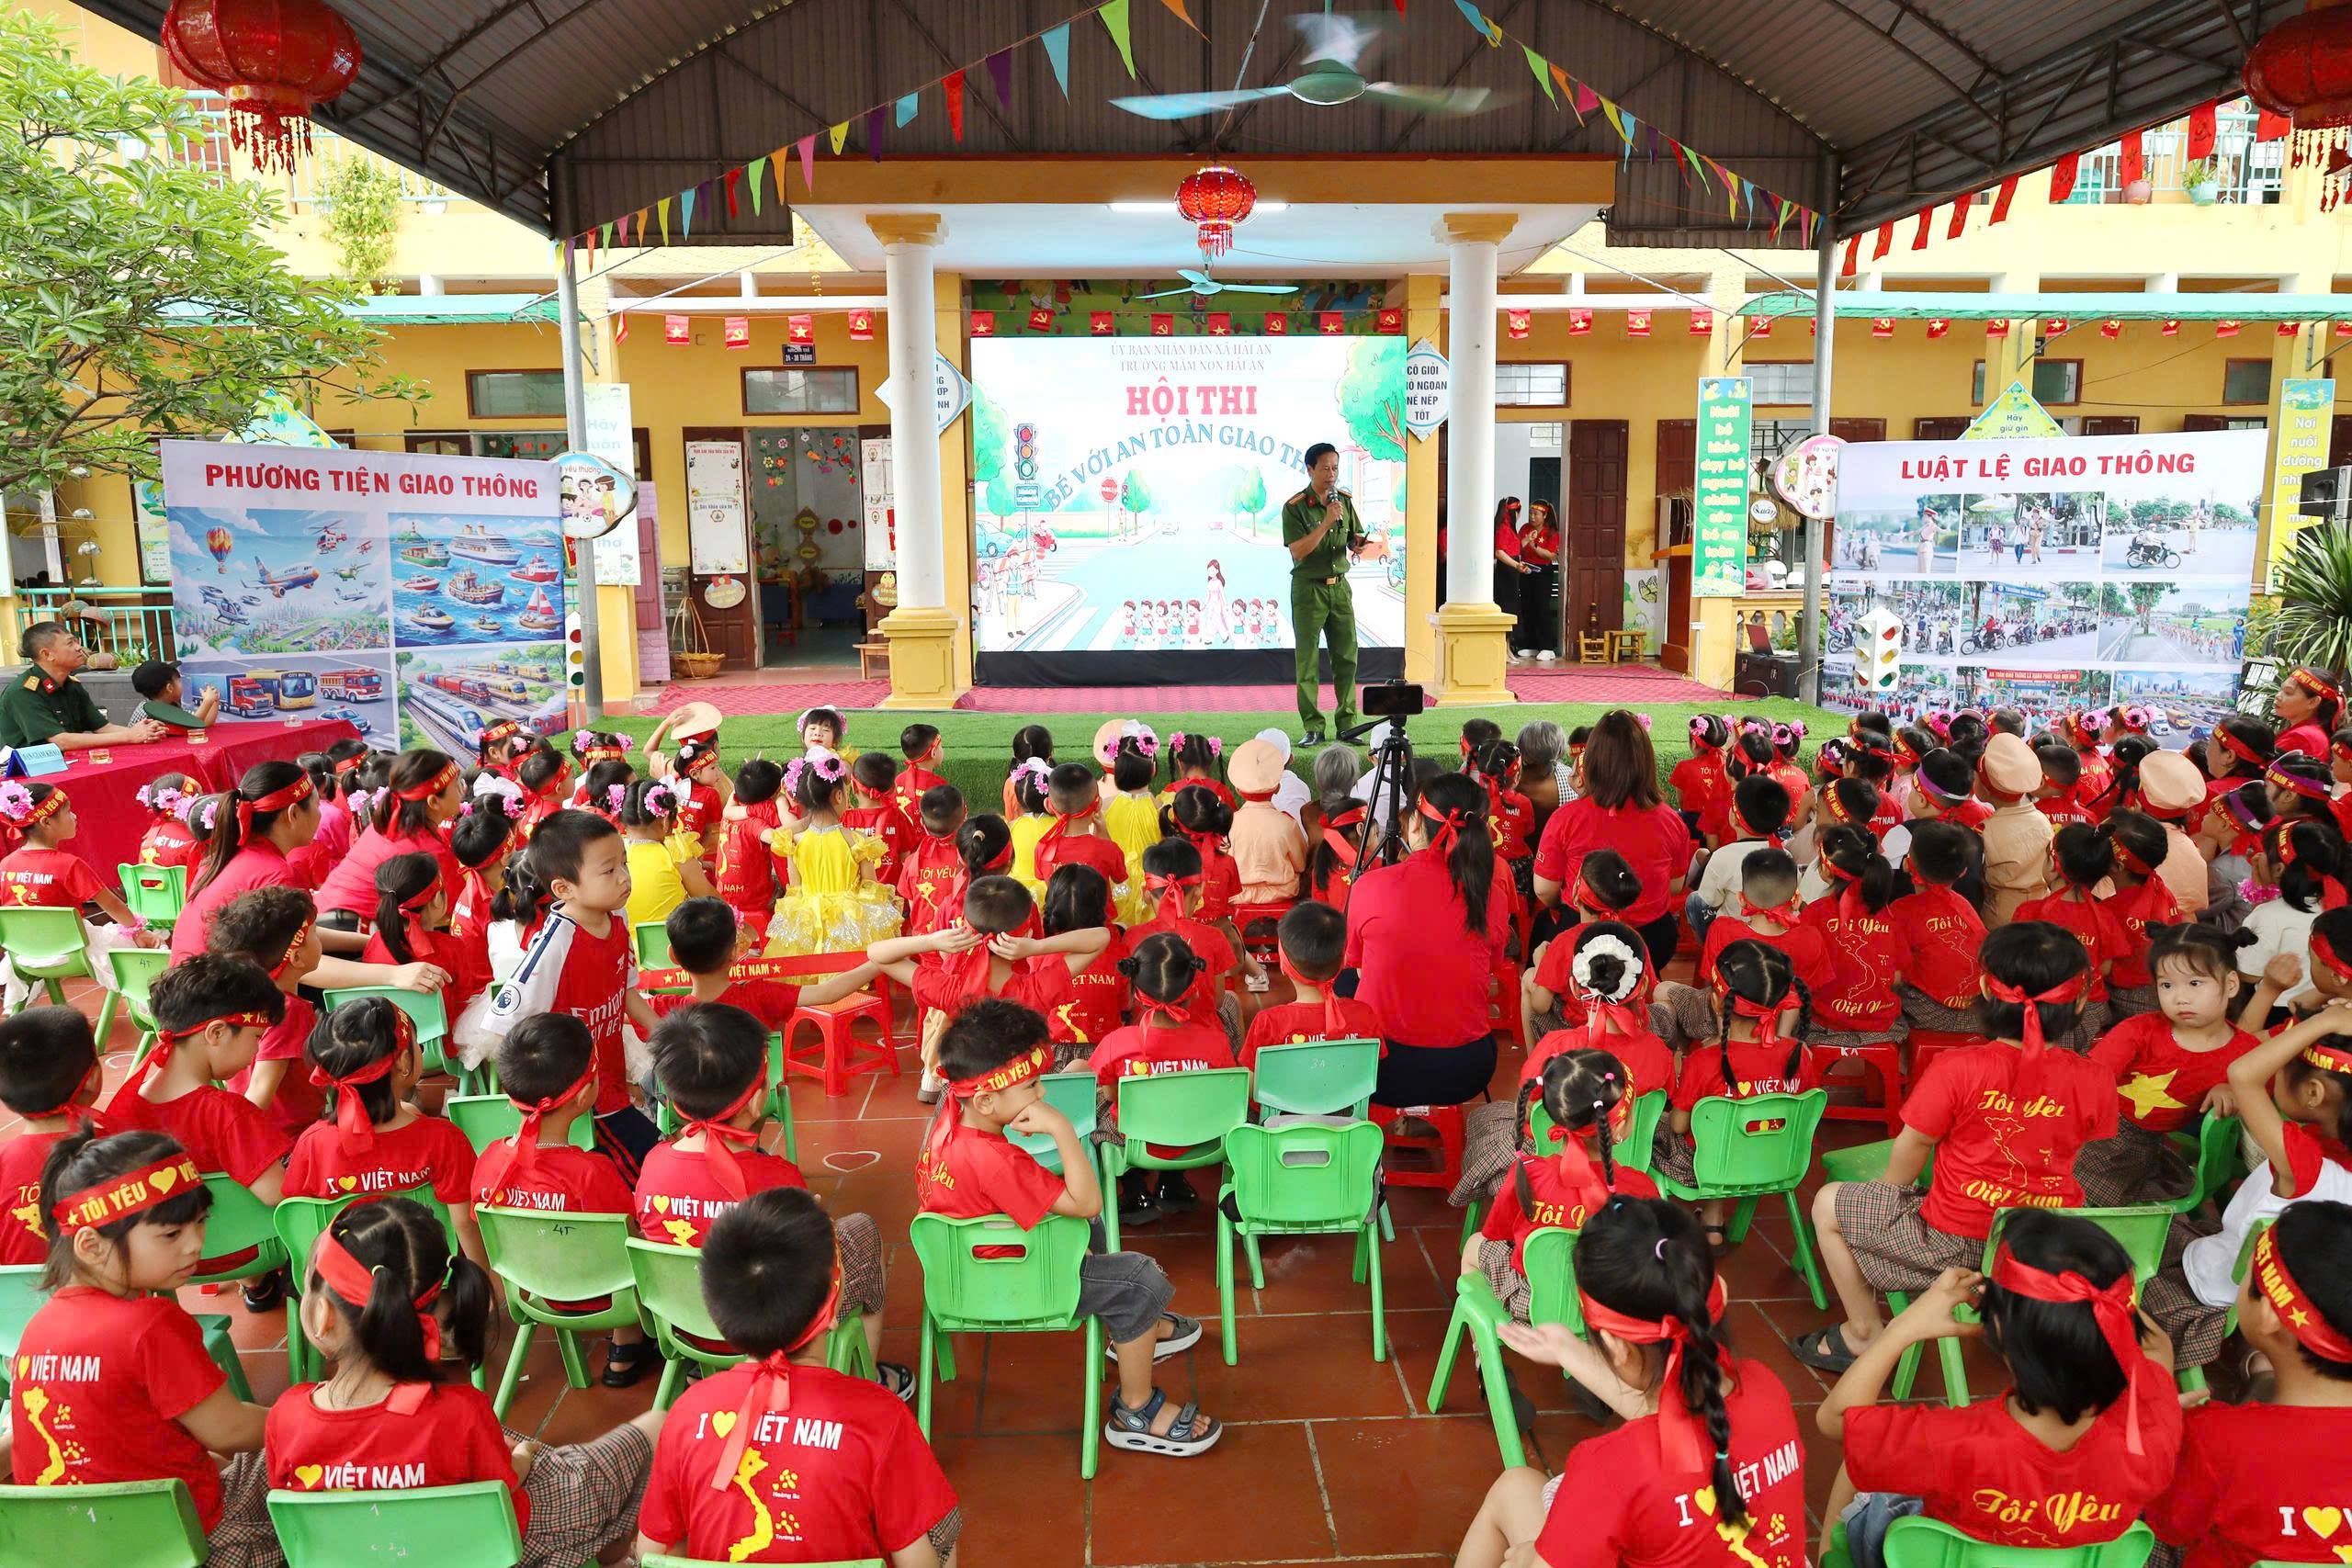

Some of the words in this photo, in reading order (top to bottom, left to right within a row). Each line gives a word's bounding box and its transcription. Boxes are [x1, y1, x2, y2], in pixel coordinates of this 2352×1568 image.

[1129, 344, 1149, 355] BAN
[1154, 342, 1185, 355] NHÂN
[1190, 342, 1212, 355] DÂN
[1256, 344, 1272, 355] AN
[1200, 360, 1222, 371] NON
[1408, 364, 1419, 375] CÔ
[1421, 361, 1439, 375] GIỎI
[1417, 381, 1447, 390] NGOAN
[1126, 376, 1189, 423] HỘI
[1196, 386, 1257, 414] THI
[1415, 408, 1430, 420] TỐT
[2295, 417, 2316, 429] Nơi
[2290, 436, 2318, 447] nuôi
[1044, 473, 1073, 512] BÉ
[1071, 448, 1113, 483] VỚI
[1117, 433, 1147, 462] AN
[1149, 419, 1213, 448] TOÀN
[1219, 425, 1274, 456] GIAO
[1902, 455, 1968, 482] LUẬT
[1979, 453, 2010, 480] LỆ
[2024, 457, 2086, 476] GIAO
[2098, 449, 2194, 475] THÔNG
[2281, 454, 2323, 469] dưỡng
[205, 462, 320, 491] PHƯƠNG
[329, 467, 390, 496] TIỆN
[399, 474, 454, 495] GIAO
[462, 472, 537, 499] THÔNG
[35, 808, 46, 818] TÔI
[44, 799, 58, 814] YÊU
[1831, 801, 1844, 818] NAM
[17, 871, 32, 884] VIỆT
[33, 874, 53, 885] NAM
[920, 866, 933, 880] TÔI
[936, 866, 957, 879] YÊU
[1859, 919, 1889, 934] Yêu
[1927, 917, 1951, 933] Tôi
[291, 929, 305, 948] YÊU
[749, 963, 770, 976] NAM
[1089, 974, 1115, 987] NAM
[1831, 998, 1864, 1014] Việt
[1125, 1059, 1131, 1075] I
[2304, 1046, 2335, 1070] NAM
[987, 1070, 1009, 1091] TÔI
[1008, 1058, 1031, 1086] YÊU
[1977, 1090, 2015, 1114] Tôi
[326, 1178, 339, 1195] I
[362, 1168, 394, 1192] VIỆT
[398, 1166, 432, 1185] NAM
[17, 1181, 41, 1205] TÔ
[80, 1200, 108, 1224] TÔI
[108, 1179, 148, 1213] YÊU
[532, 1191, 565, 1212] NAM
[1961, 1179, 2011, 1207] Việt
[644, 1196, 650, 1213] I
[671, 1195, 700, 1219] VIỆT
[1531, 1200, 1563, 1224] Tôi
[2263, 1260, 2294, 1308] NAM
[30, 1348, 58, 1385] VIỆT
[60, 1355, 101, 1382] NAM
[695, 1412, 708, 1440] I
[753, 1411, 789, 1446] IỆT
[793, 1416, 843, 1450] NAM
[372, 1462, 425, 1486] NAM
[1675, 1494, 1693, 1528] I
[1734, 1461, 1759, 1504] IỆT
[1763, 1439, 1799, 1484] NAM
[1973, 1489, 2039, 1524] Tôi
[2045, 1490, 2122, 1535] Yêu
[2278, 1506, 2297, 1536] I
